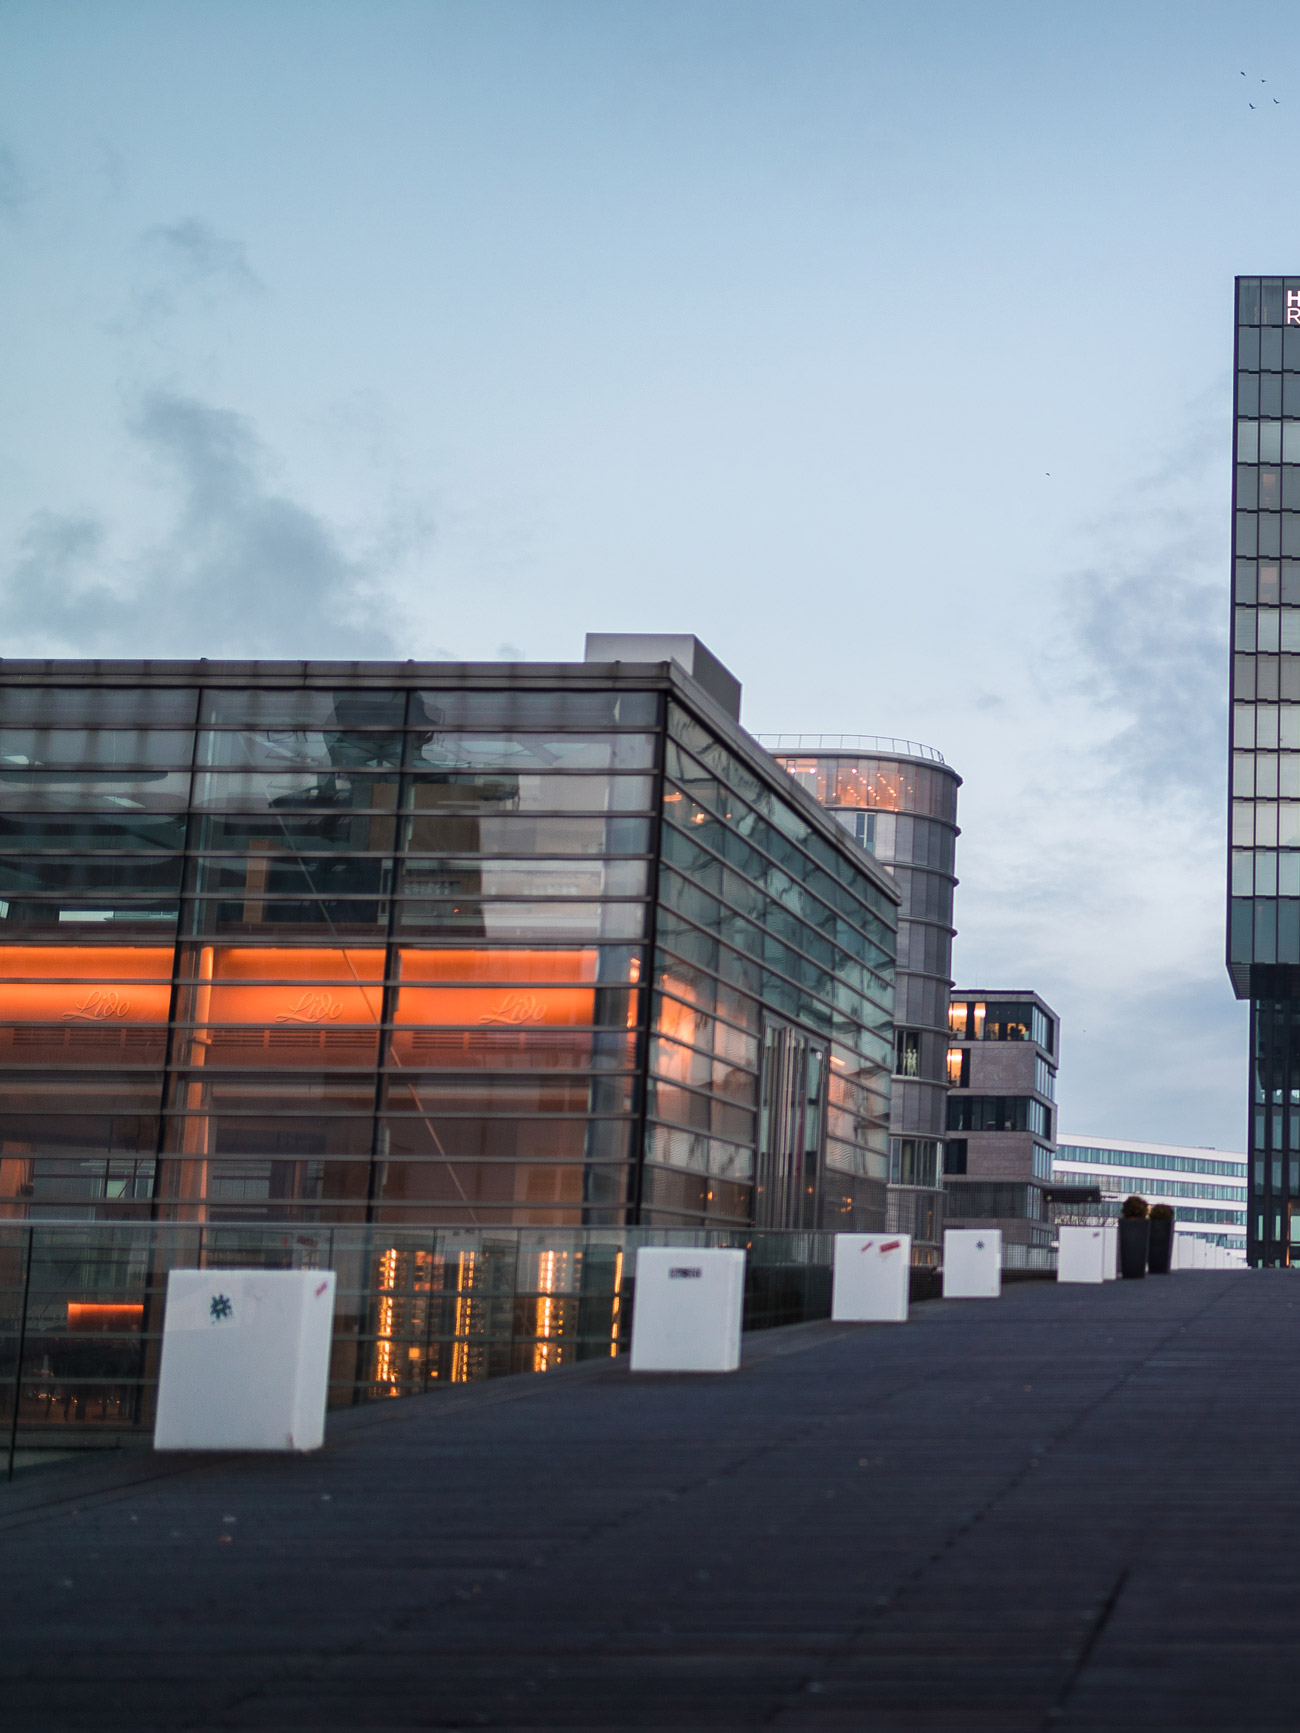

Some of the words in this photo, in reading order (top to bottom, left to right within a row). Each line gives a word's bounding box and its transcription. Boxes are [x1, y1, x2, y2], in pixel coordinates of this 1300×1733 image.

[62, 991, 131, 1021] Lido
[274, 991, 344, 1024] Lido
[478, 993, 547, 1025] Lido
